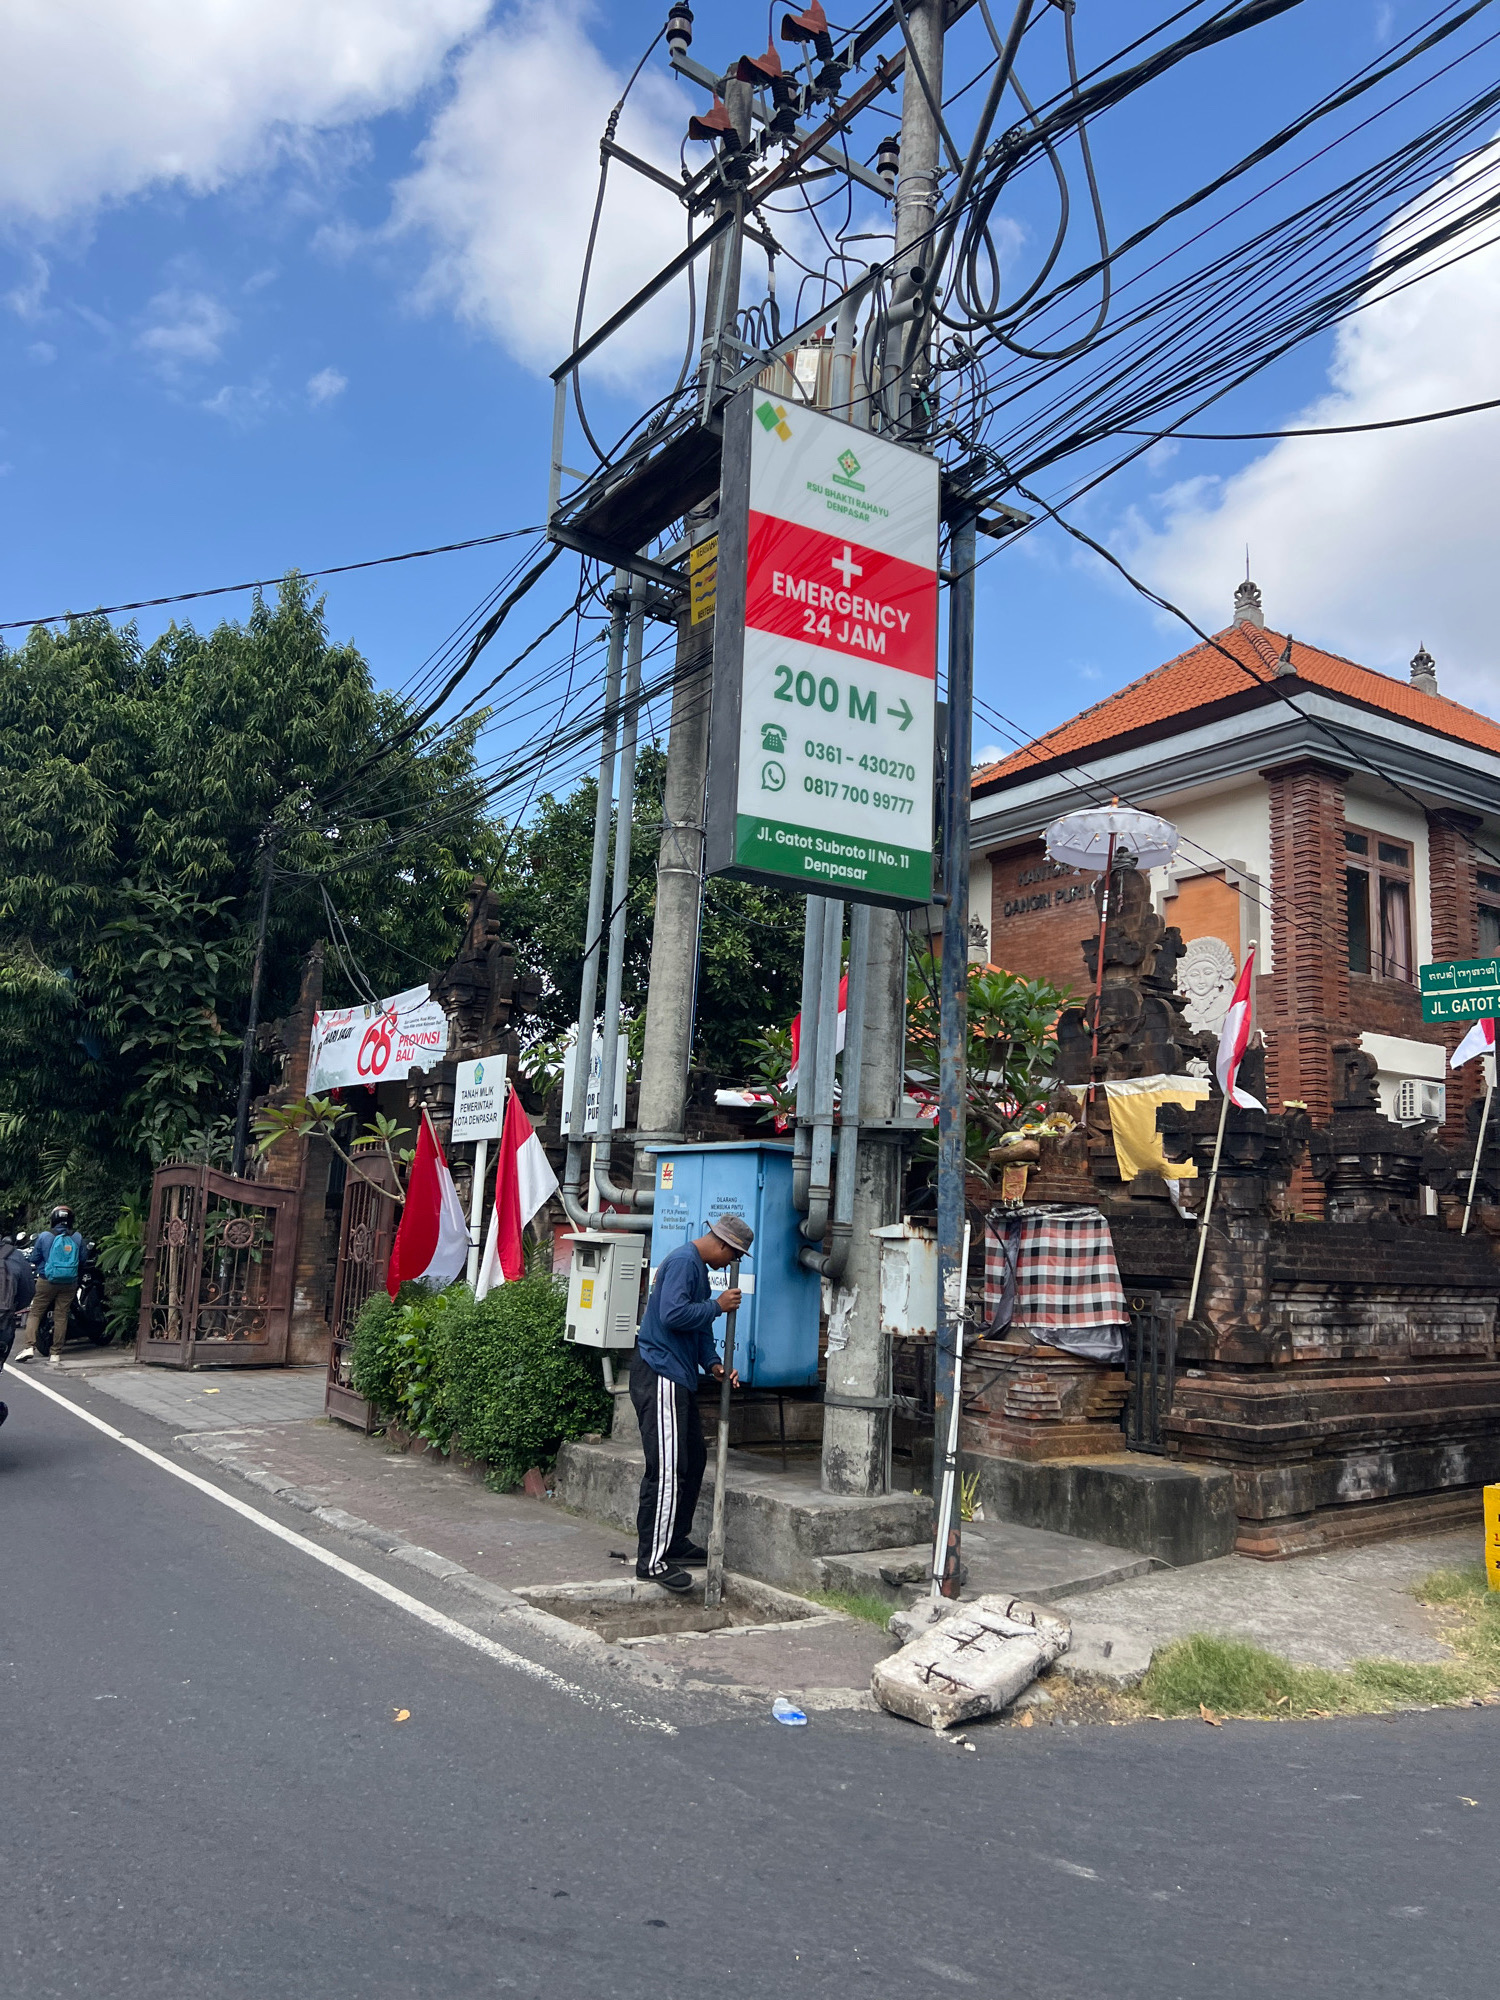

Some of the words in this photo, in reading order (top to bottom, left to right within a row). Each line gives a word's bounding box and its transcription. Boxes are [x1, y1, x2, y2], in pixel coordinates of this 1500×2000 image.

[806, 481, 823, 494] RSU
[824, 487, 855, 506] BHAKTI
[855, 499, 889, 518] RAHAYU
[826, 500, 870, 522] DENPASAR
[772, 570, 911, 634] EMERGENCY
[802, 608, 832, 639] 24
[836, 620, 886, 655] JAM
[773, 664, 839, 713] 200
[848, 685, 877, 725] M
[804, 739, 842, 765] 0361
[858, 754, 916, 782] 430270
[803, 776, 839, 798] 0817
[841, 784, 870, 805] 700
[872, 791, 914, 815] 99777
[756, 826, 773, 842] Jl.
[775, 830, 813, 849] Gatot
[815, 837, 867, 860] Subroto
[877, 850, 898, 867] No.
[900, 854, 910, 869] 11
[804, 856, 868, 881] Denpasar
[1431, 1001, 1449, 1015] JL.
[1451, 996, 1494, 1013] GATOT
[398, 1031, 441, 1048] PROVINSI
[395, 1048, 416, 1063] BALI
[462, 1090, 479, 1100] TANAH
[479, 1085, 495, 1098] MILIK
[453, 1115, 468, 1127] KOTA
[468, 1112, 498, 1126] DENPASAR
[459, 1100, 494, 1114] PEMERINTAH
